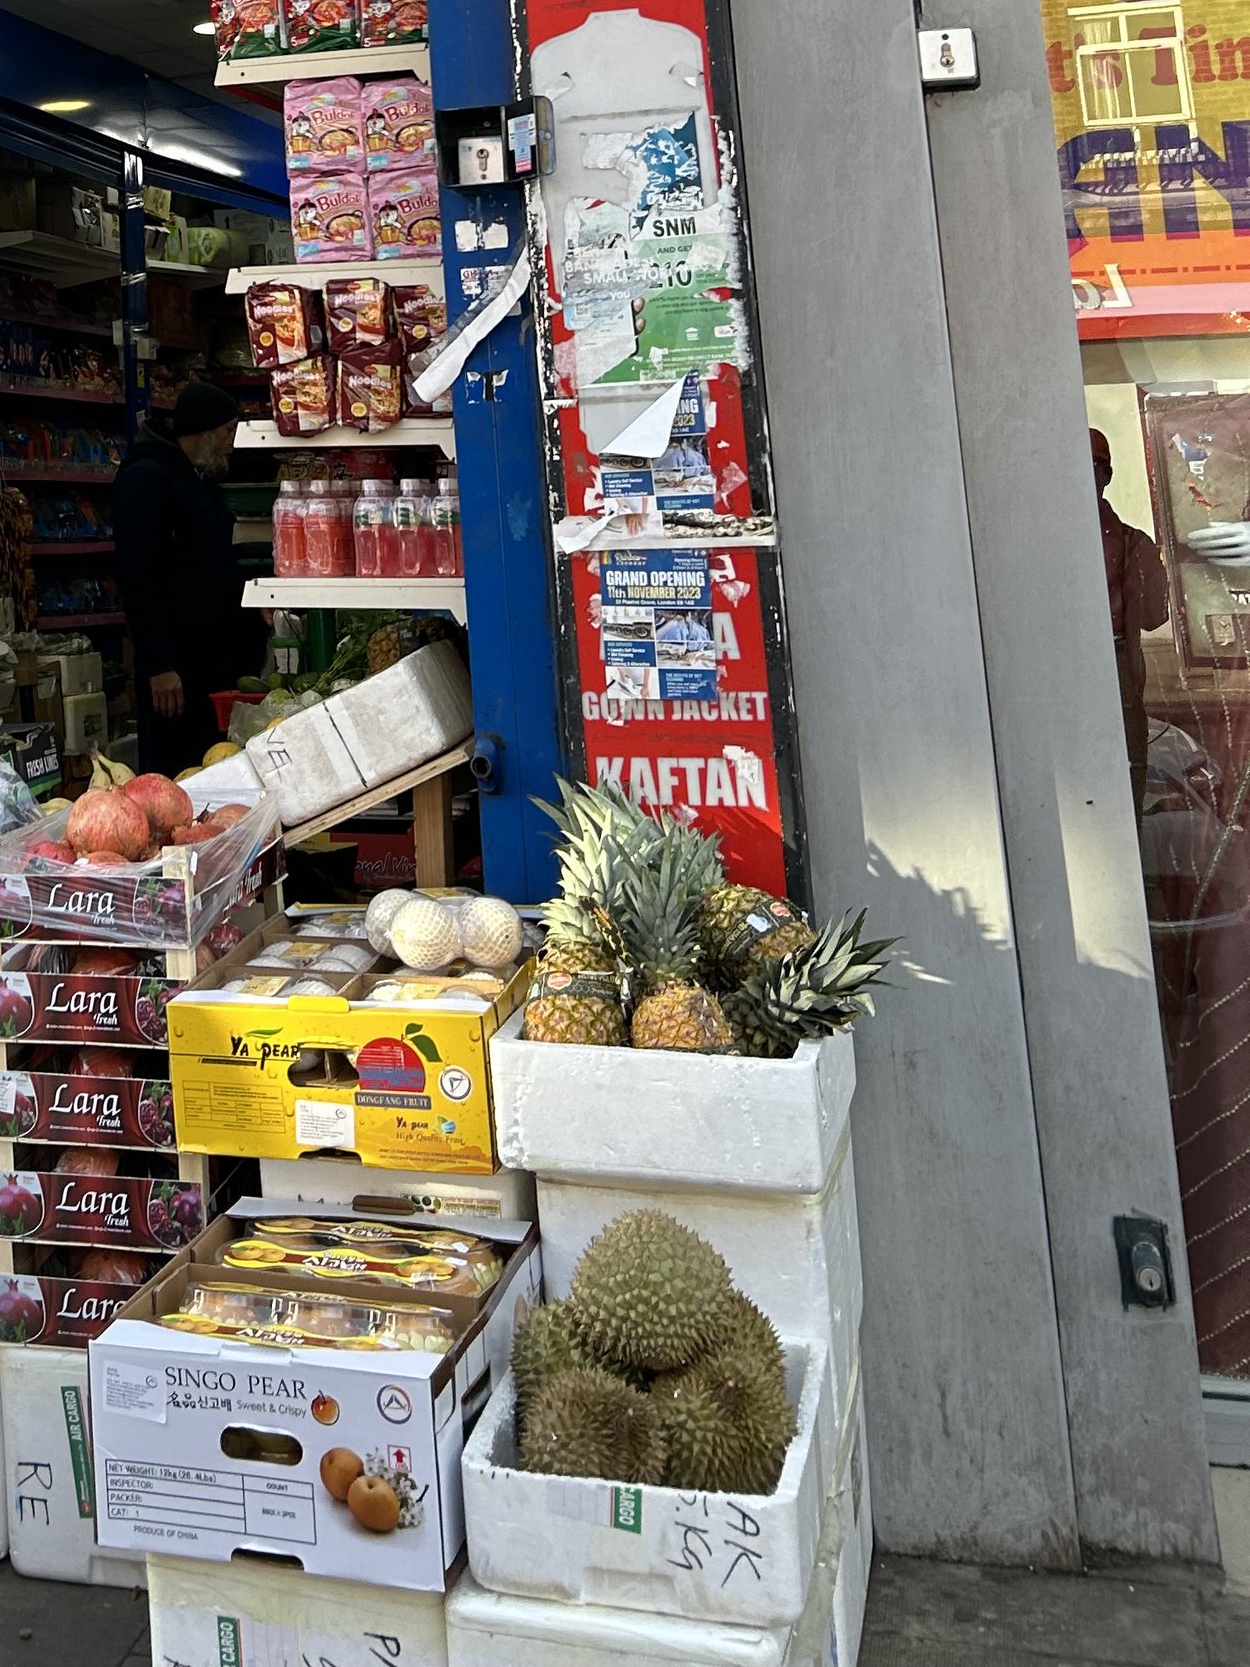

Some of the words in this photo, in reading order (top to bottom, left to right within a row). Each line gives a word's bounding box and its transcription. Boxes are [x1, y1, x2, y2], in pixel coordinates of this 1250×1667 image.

[653, 216, 696, 237] SNM
[657, 246, 676, 254] AND
[606, 570, 648, 586] GRAND
[650, 571, 705, 587] OPENING
[607, 586, 626, 599] 11th
[627, 586, 675, 599] NOVEMBER
[676, 587, 702, 600] 2023
[26, 756, 44, 779] FRESH
[45, 882, 116, 915] Lara
[46, 981, 118, 1016] Lara
[49, 1082, 120, 1117] Lara
[357, 1092, 403, 1107] DONGFANG
[404, 1095, 430, 1109] FRUIT
[395, 1130, 412, 1143] High
[56, 1181, 130, 1217] Lara
[164, 1366, 236, 1392] SINGO
[247, 1374, 307, 1400] PEAR
[63, 1389, 82, 1424] CARGO
[236, 1400, 267, 1413] Sweet
[269, 1402, 277, 1414] &
[278, 1403, 308, 1418] Crispy
[70, 1424, 84, 1442] AIR
[177, 1529, 199, 1541] CHINA
[219, 1621, 236, 1663] CARGO
